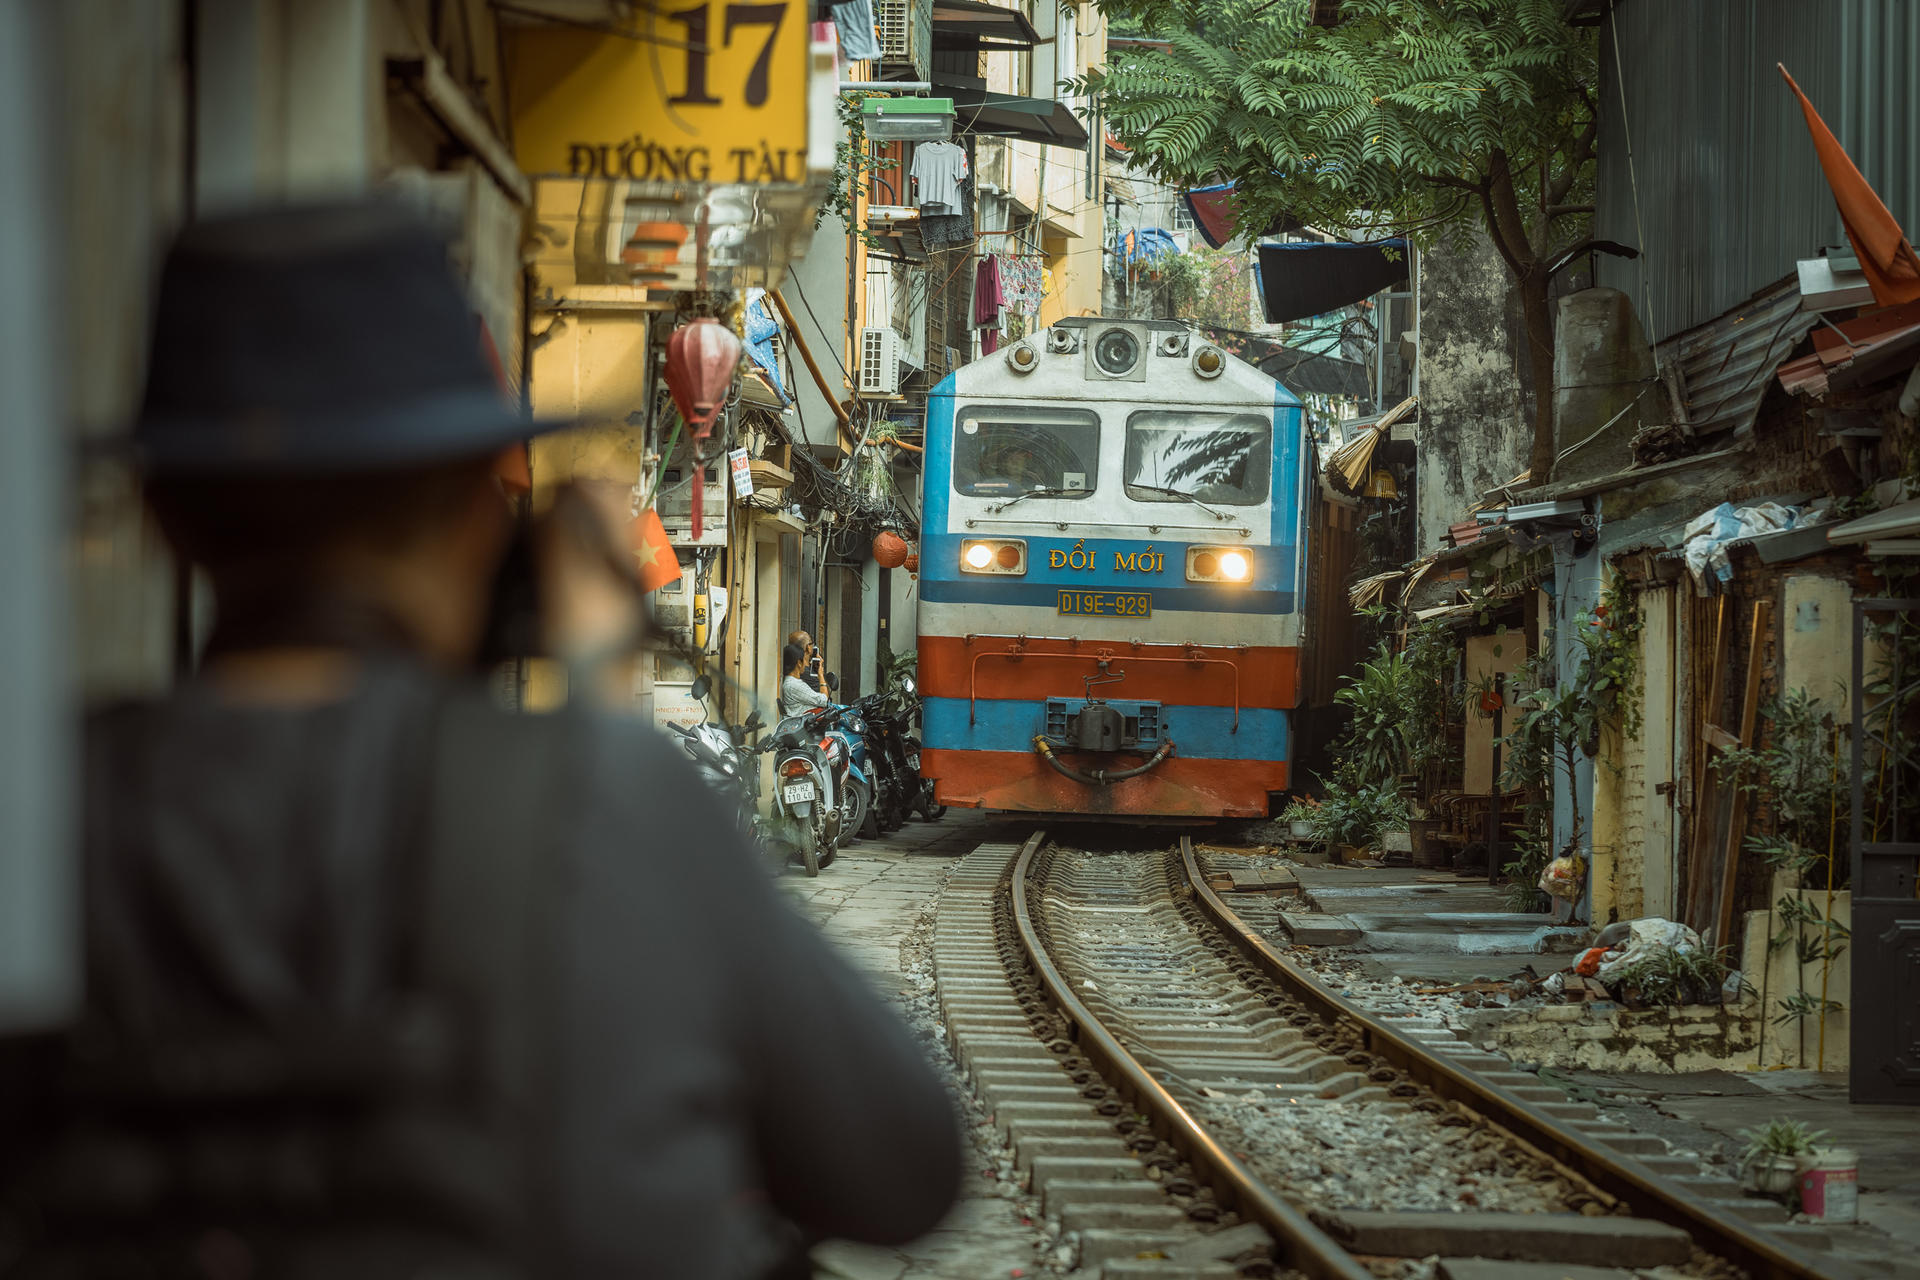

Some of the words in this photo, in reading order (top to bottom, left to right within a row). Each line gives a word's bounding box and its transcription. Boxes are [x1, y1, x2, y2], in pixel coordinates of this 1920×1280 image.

[667, 2, 789, 108] 17
[569, 133, 711, 182] ĐƯỜNG
[1049, 538, 1097, 570] ĐỔI
[1113, 545, 1165, 572] MỚI
[1062, 594, 1147, 615] D19E-929
